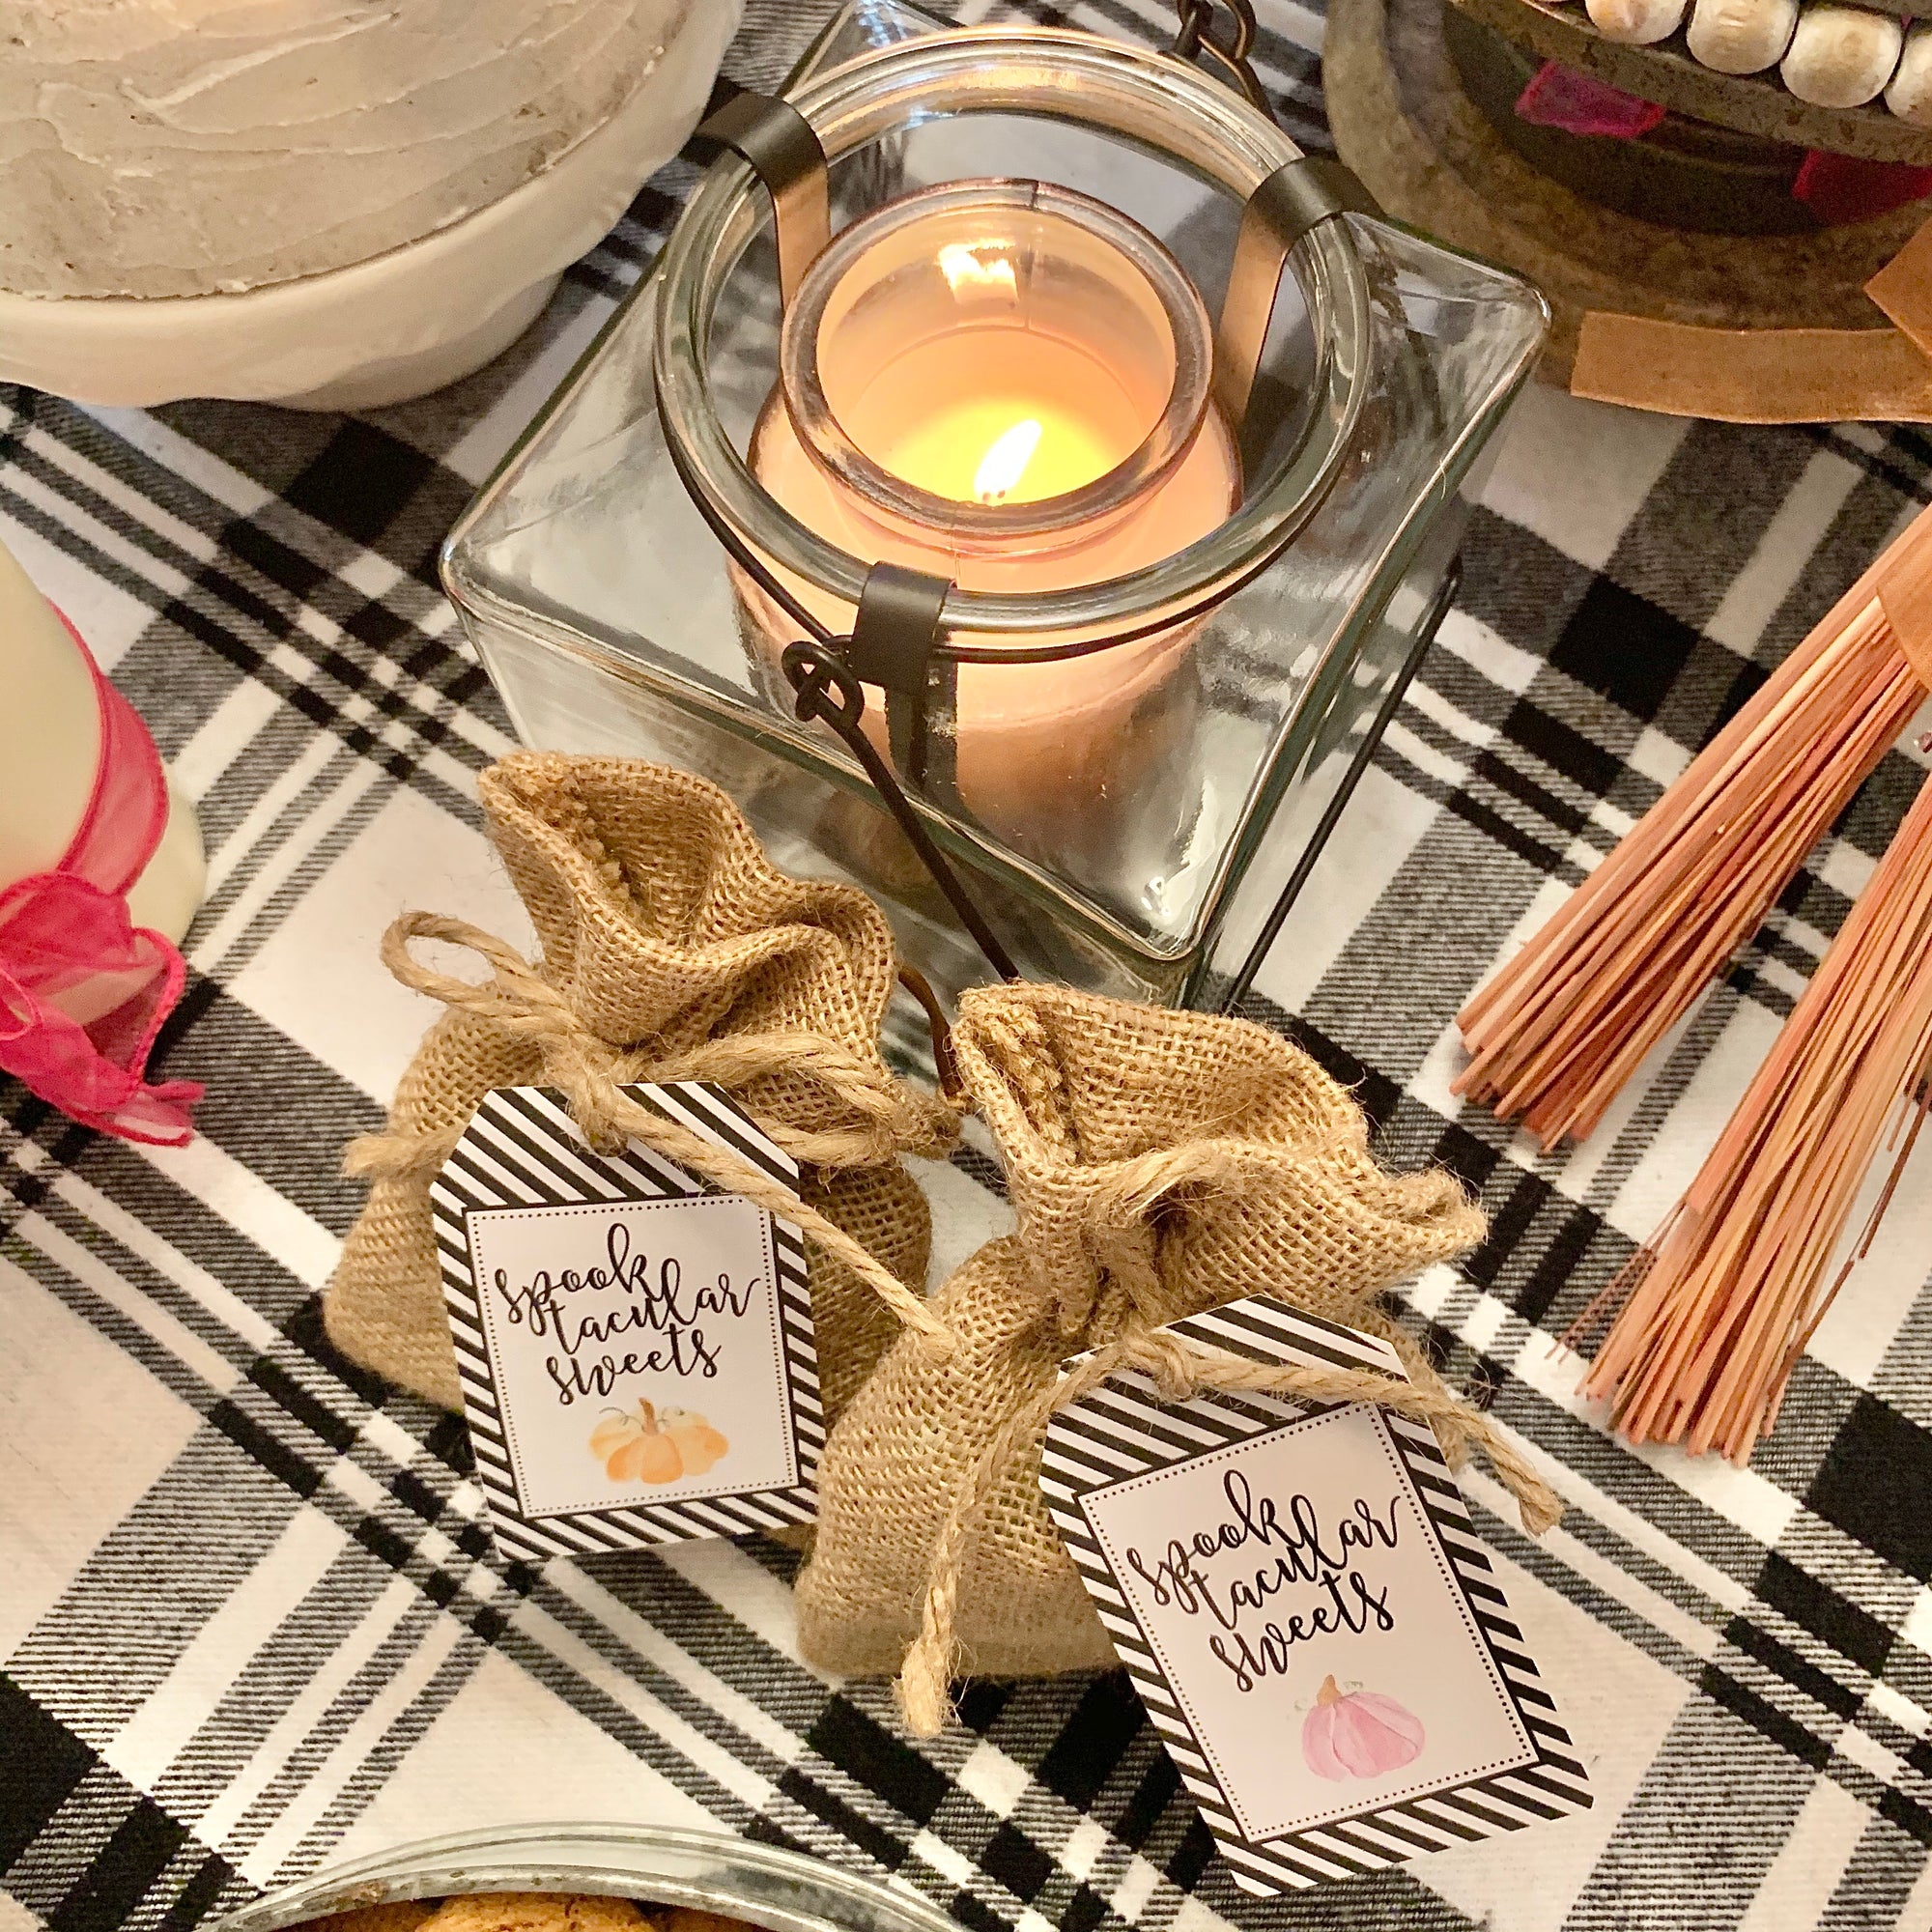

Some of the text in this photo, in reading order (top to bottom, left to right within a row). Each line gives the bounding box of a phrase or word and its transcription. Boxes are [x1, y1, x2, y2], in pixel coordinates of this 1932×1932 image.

[495, 1223, 661, 1336] spook
[544, 1258, 760, 1354] tacular
[546, 1322, 722, 1405] sweets
[1126, 1469, 1303, 1614] spook
[1188, 1494, 1401, 1630] tacular
[1209, 1570, 1394, 1691] sweets
